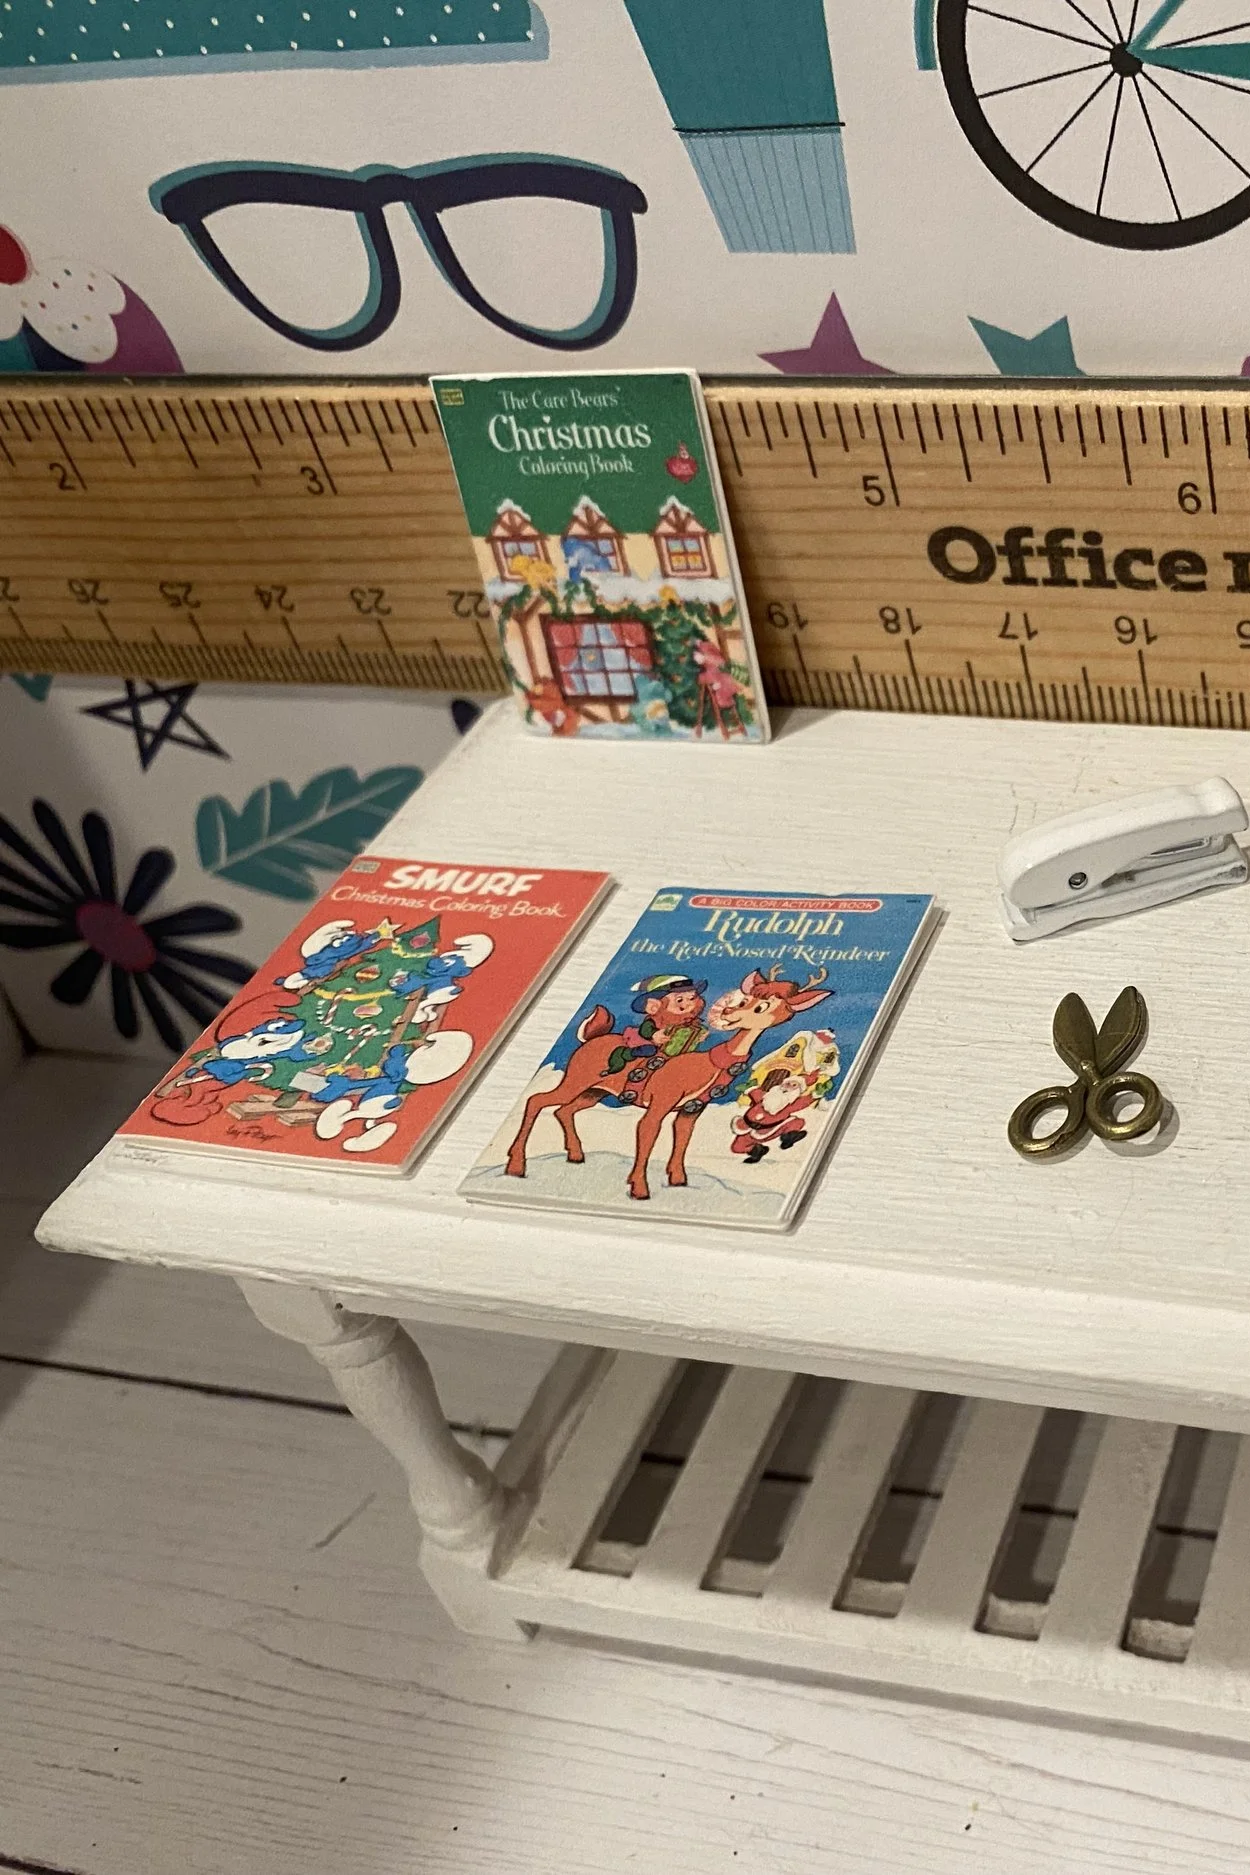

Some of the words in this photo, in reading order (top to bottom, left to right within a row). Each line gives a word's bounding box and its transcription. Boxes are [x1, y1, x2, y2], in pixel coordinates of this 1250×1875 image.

[499, 390, 528, 410] The
[533, 389, 568, 409] Care
[488, 414, 652, 452] Christmas
[49, 462, 76, 490] 2
[301, 466, 324, 495] 3
[519, 455, 590, 480] Coloring
[589, 453, 635, 474] Book
[862, 475, 886, 507] 5
[1178, 482, 1202, 515] 6
[927, 525, 1209, 592] Office
[68, 577, 110, 606] 26
[158, 581, 201, 609] 25
[255, 584, 295, 612] 24
[350, 587, 392, 616] 23
[767, 601, 809, 630] 19
[878, 605, 922, 635] 18
[997, 611, 1040, 641] 17
[1114, 614, 1159, 645] 16
[383, 864, 544, 897] SMURF
[330, 885, 426, 910] Christmas
[429, 895, 508, 920] Coloring
[508, 900, 567, 918] Book
[838, 901, 876, 911] BOOK
[703, 909, 844, 942] Rudolph
[631, 938, 665, 953] the
